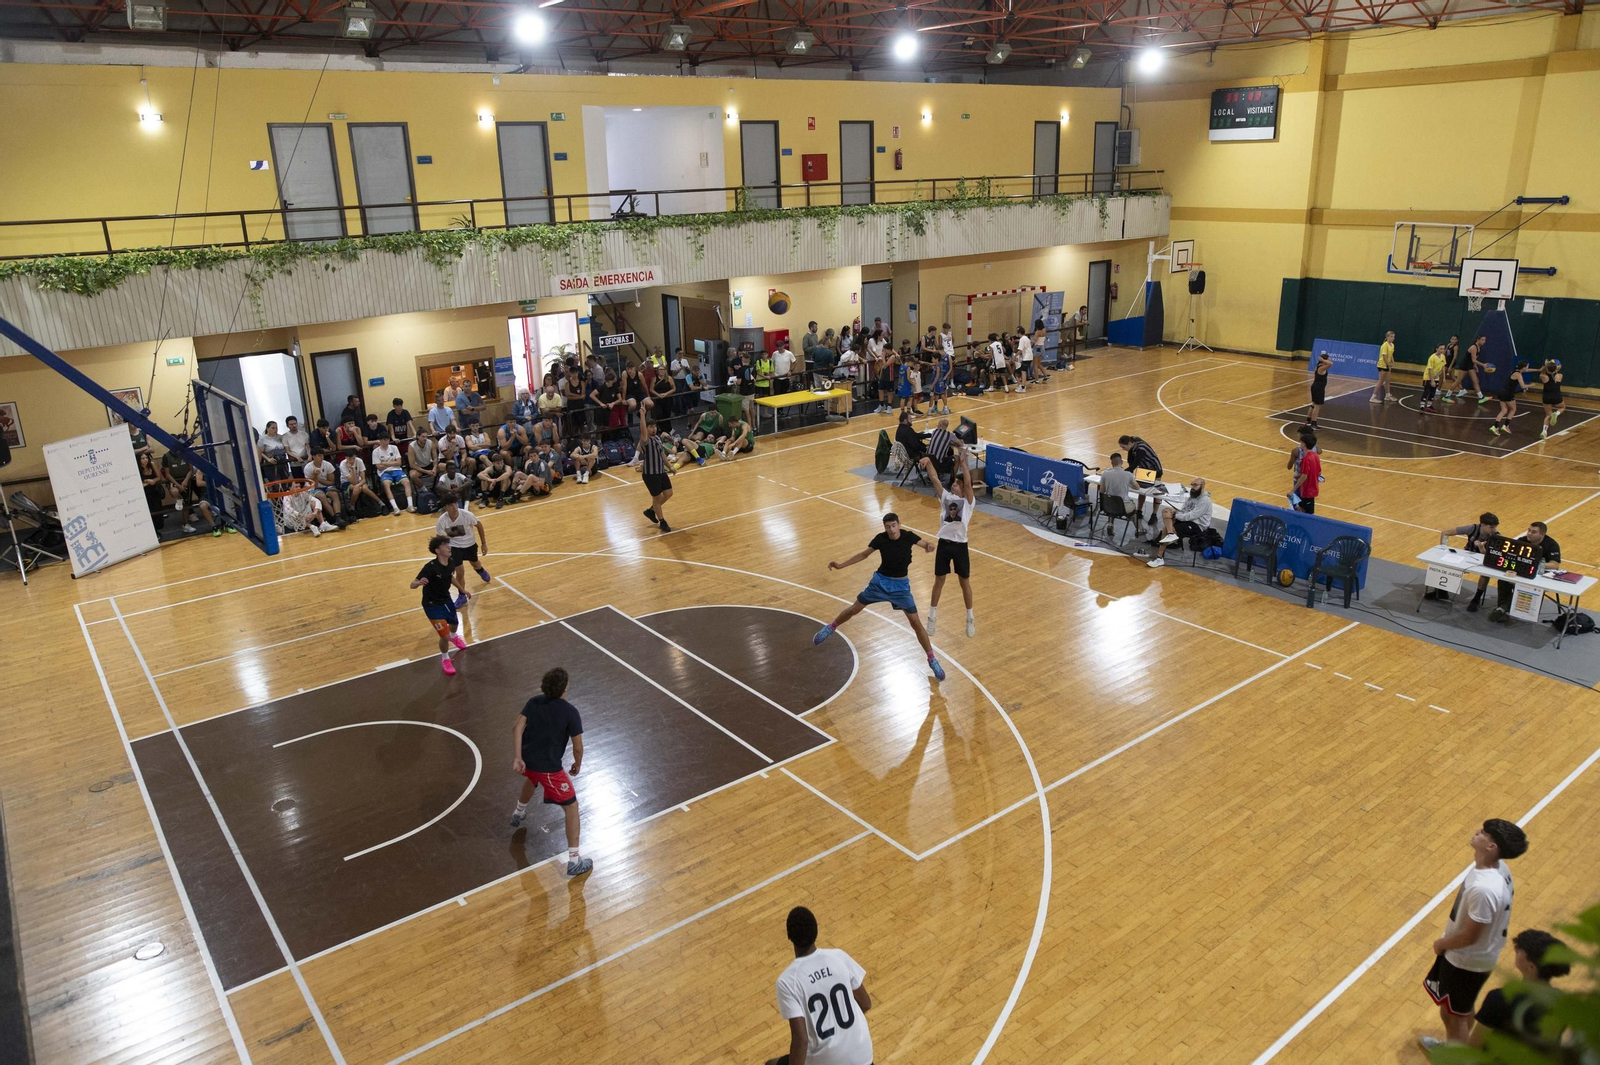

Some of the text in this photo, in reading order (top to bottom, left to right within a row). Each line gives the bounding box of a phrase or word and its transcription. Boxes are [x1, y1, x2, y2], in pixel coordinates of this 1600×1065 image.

[1214, 106, 1274, 116] LOCAL VISITANTE
[593, 270, 655, 287] EMERXENCIA
[605, 335, 630, 345] OFICINAS
[77, 461, 113, 476] DEPUTACIÓN
[83, 468, 110, 480] OURENSE
[994, 473, 1024, 485] DEPUTACIÓN
[1501, 540, 1532, 558] 3:17
[1496, 556, 1505, 567] 3
[1529, 566, 1535, 575] 1
[1438, 576, 1448, 588] 2
[808, 966, 832, 984] JOEL
[808, 982, 855, 1041] 20
